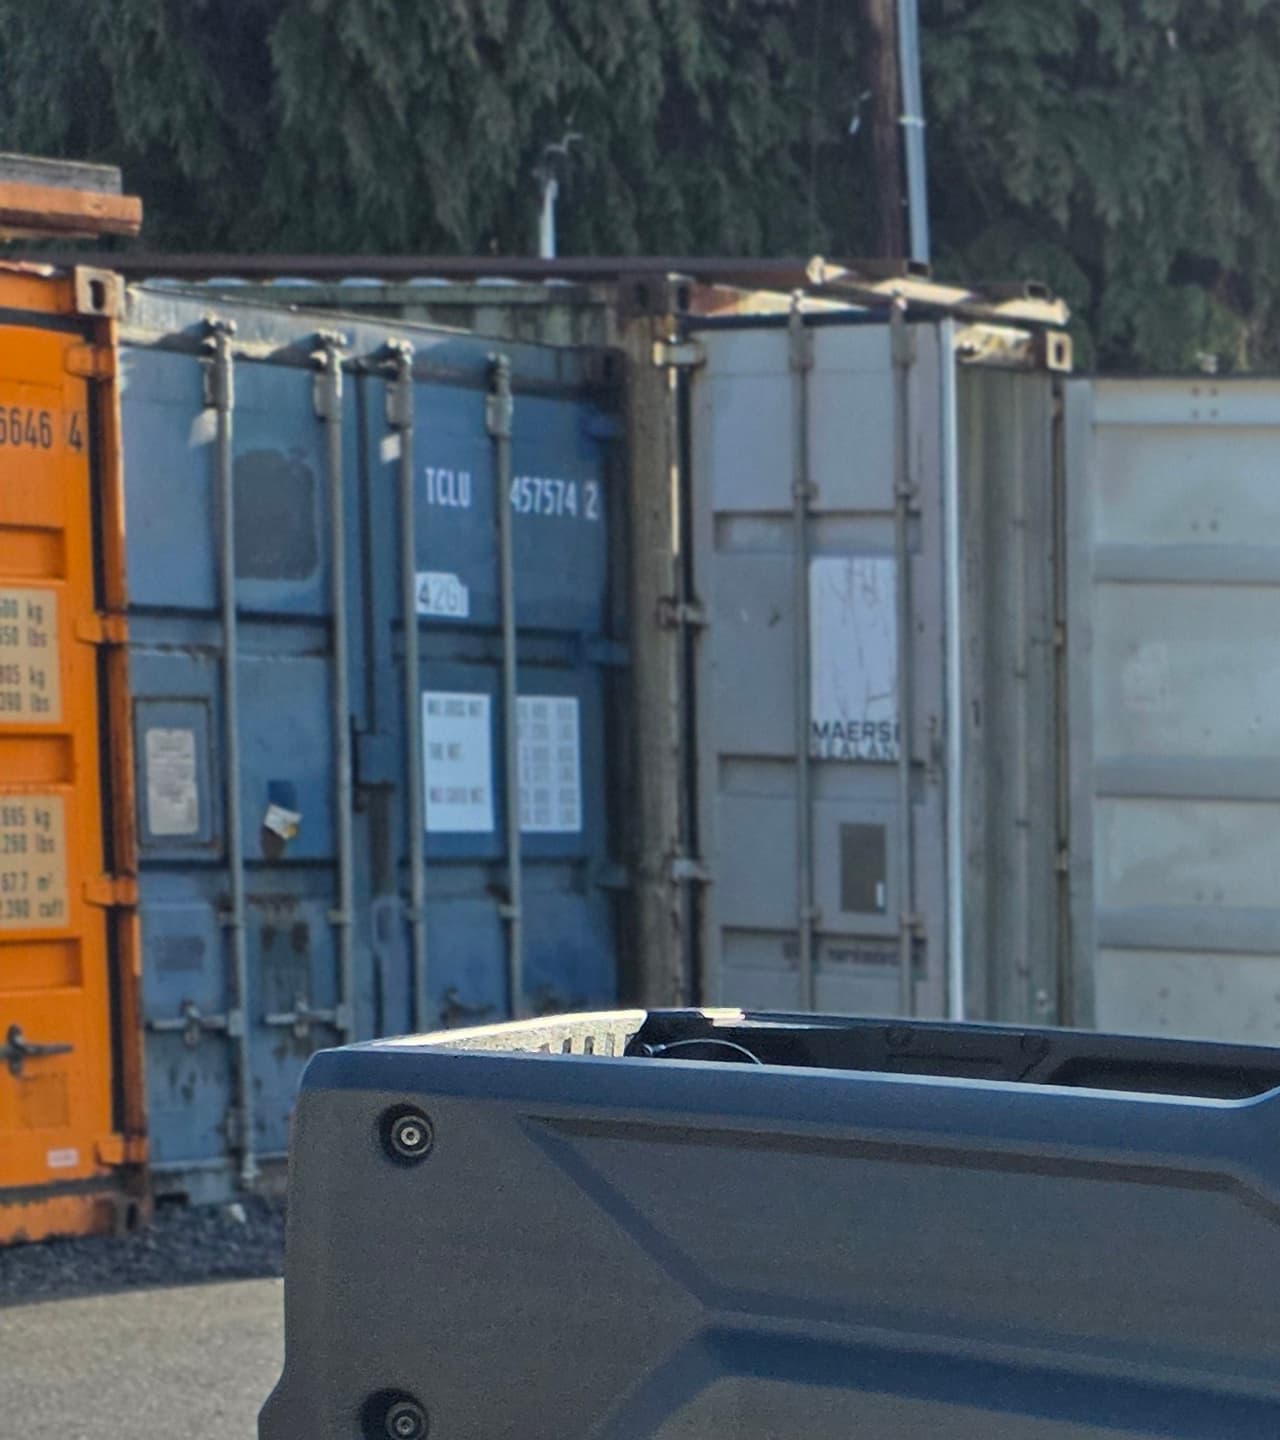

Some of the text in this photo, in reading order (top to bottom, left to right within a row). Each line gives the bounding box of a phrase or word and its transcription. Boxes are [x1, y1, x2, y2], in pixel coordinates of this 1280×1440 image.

[69, 411, 83, 453] 4
[425, 467, 599, 520] TCLU 457574 2
[27, 600, 43, 625] kg
[28, 627, 48, 648] lbs
[29, 665, 46, 691] kg
[30, 692, 50, 712] lbs
[34, 808, 51, 832] kg
[36, 834, 55, 854] lbs
